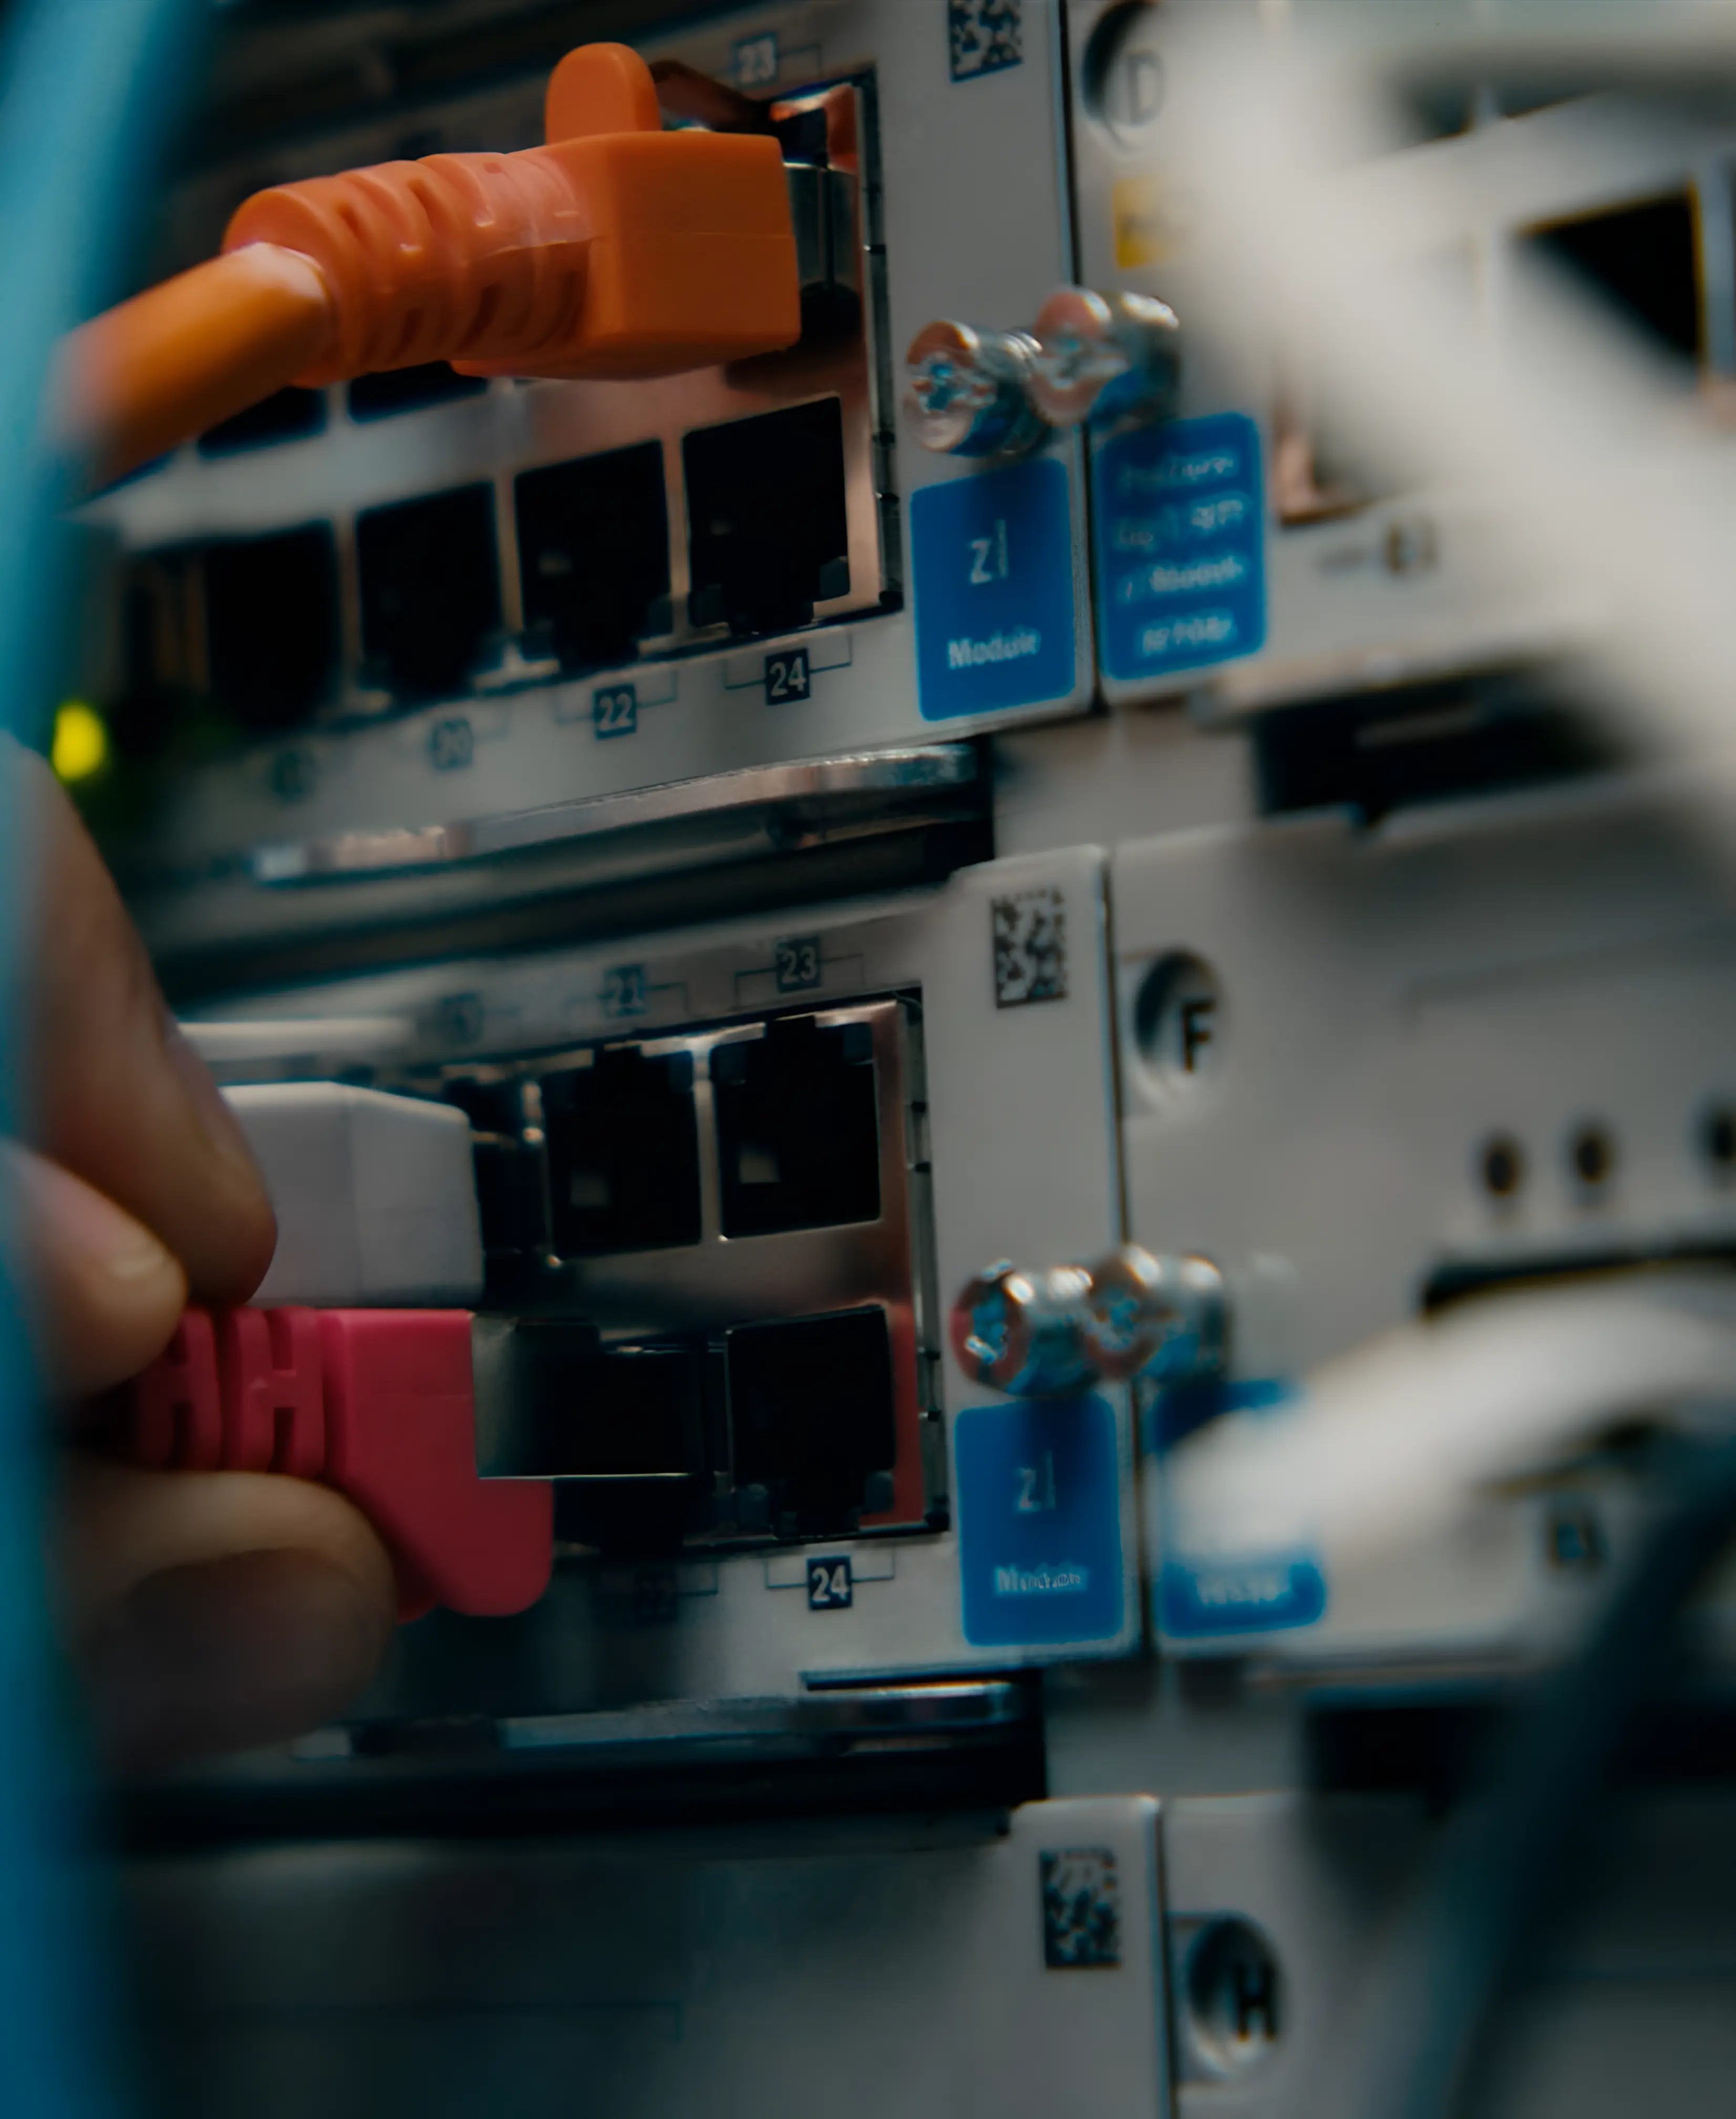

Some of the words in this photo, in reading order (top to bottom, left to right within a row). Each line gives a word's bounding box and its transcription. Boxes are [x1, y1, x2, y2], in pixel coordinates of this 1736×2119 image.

[738, 40, 775, 83] 23
[770, 653, 805, 696] 24
[598, 693, 631, 729] 22
[782, 946, 815, 983] 23
[1182, 999, 1215, 1073] F
[811, 1565, 849, 1602] 24
[1234, 1962, 1276, 2041] H
